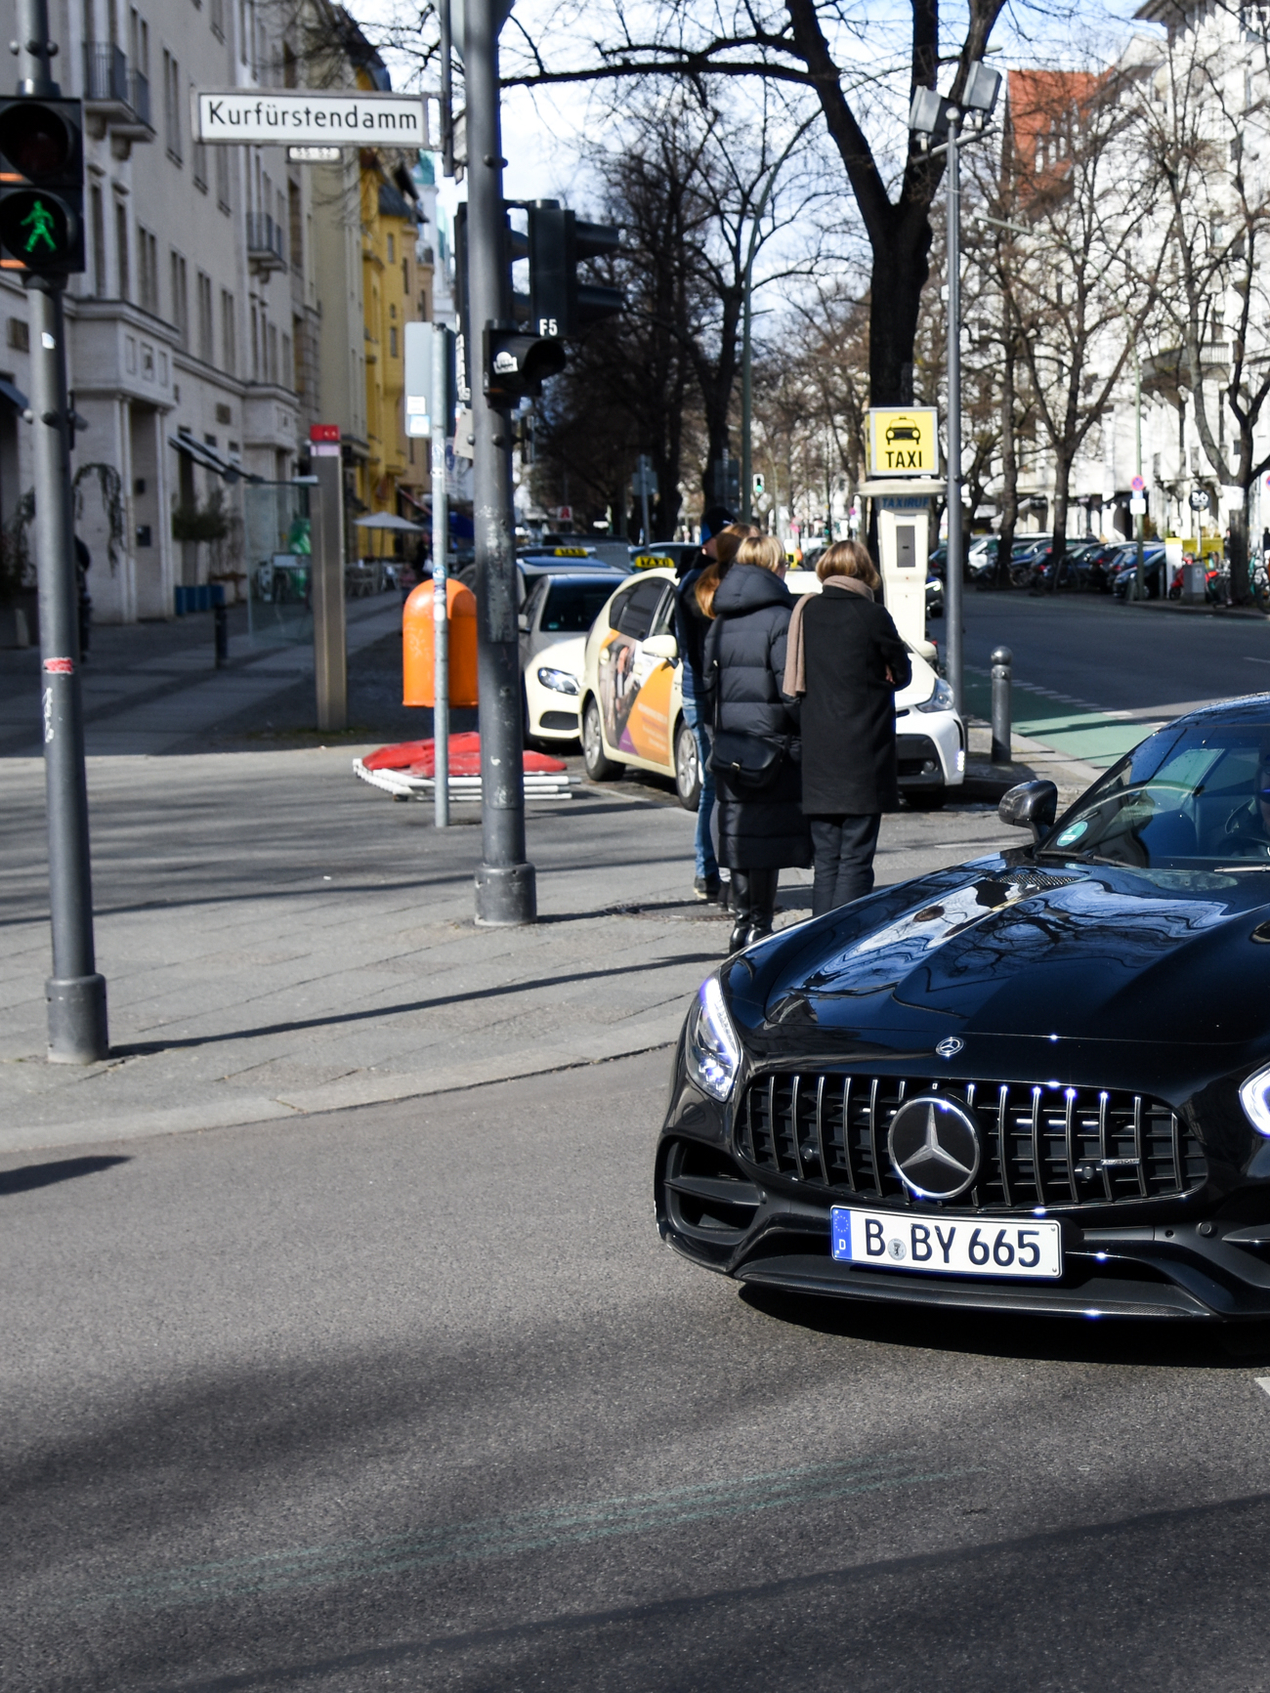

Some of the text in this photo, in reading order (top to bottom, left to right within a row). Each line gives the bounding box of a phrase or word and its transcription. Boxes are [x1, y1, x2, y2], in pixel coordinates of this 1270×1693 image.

[209, 100, 417, 129] Kurfürstendamm
[539, 318, 558, 336] F5
[885, 451, 922, 468] TAXI
[882, 497, 929, 508] TAXIRUF
[838, 1240, 846, 1250] D
[864, 1218, 1041, 1268] B BY 665
